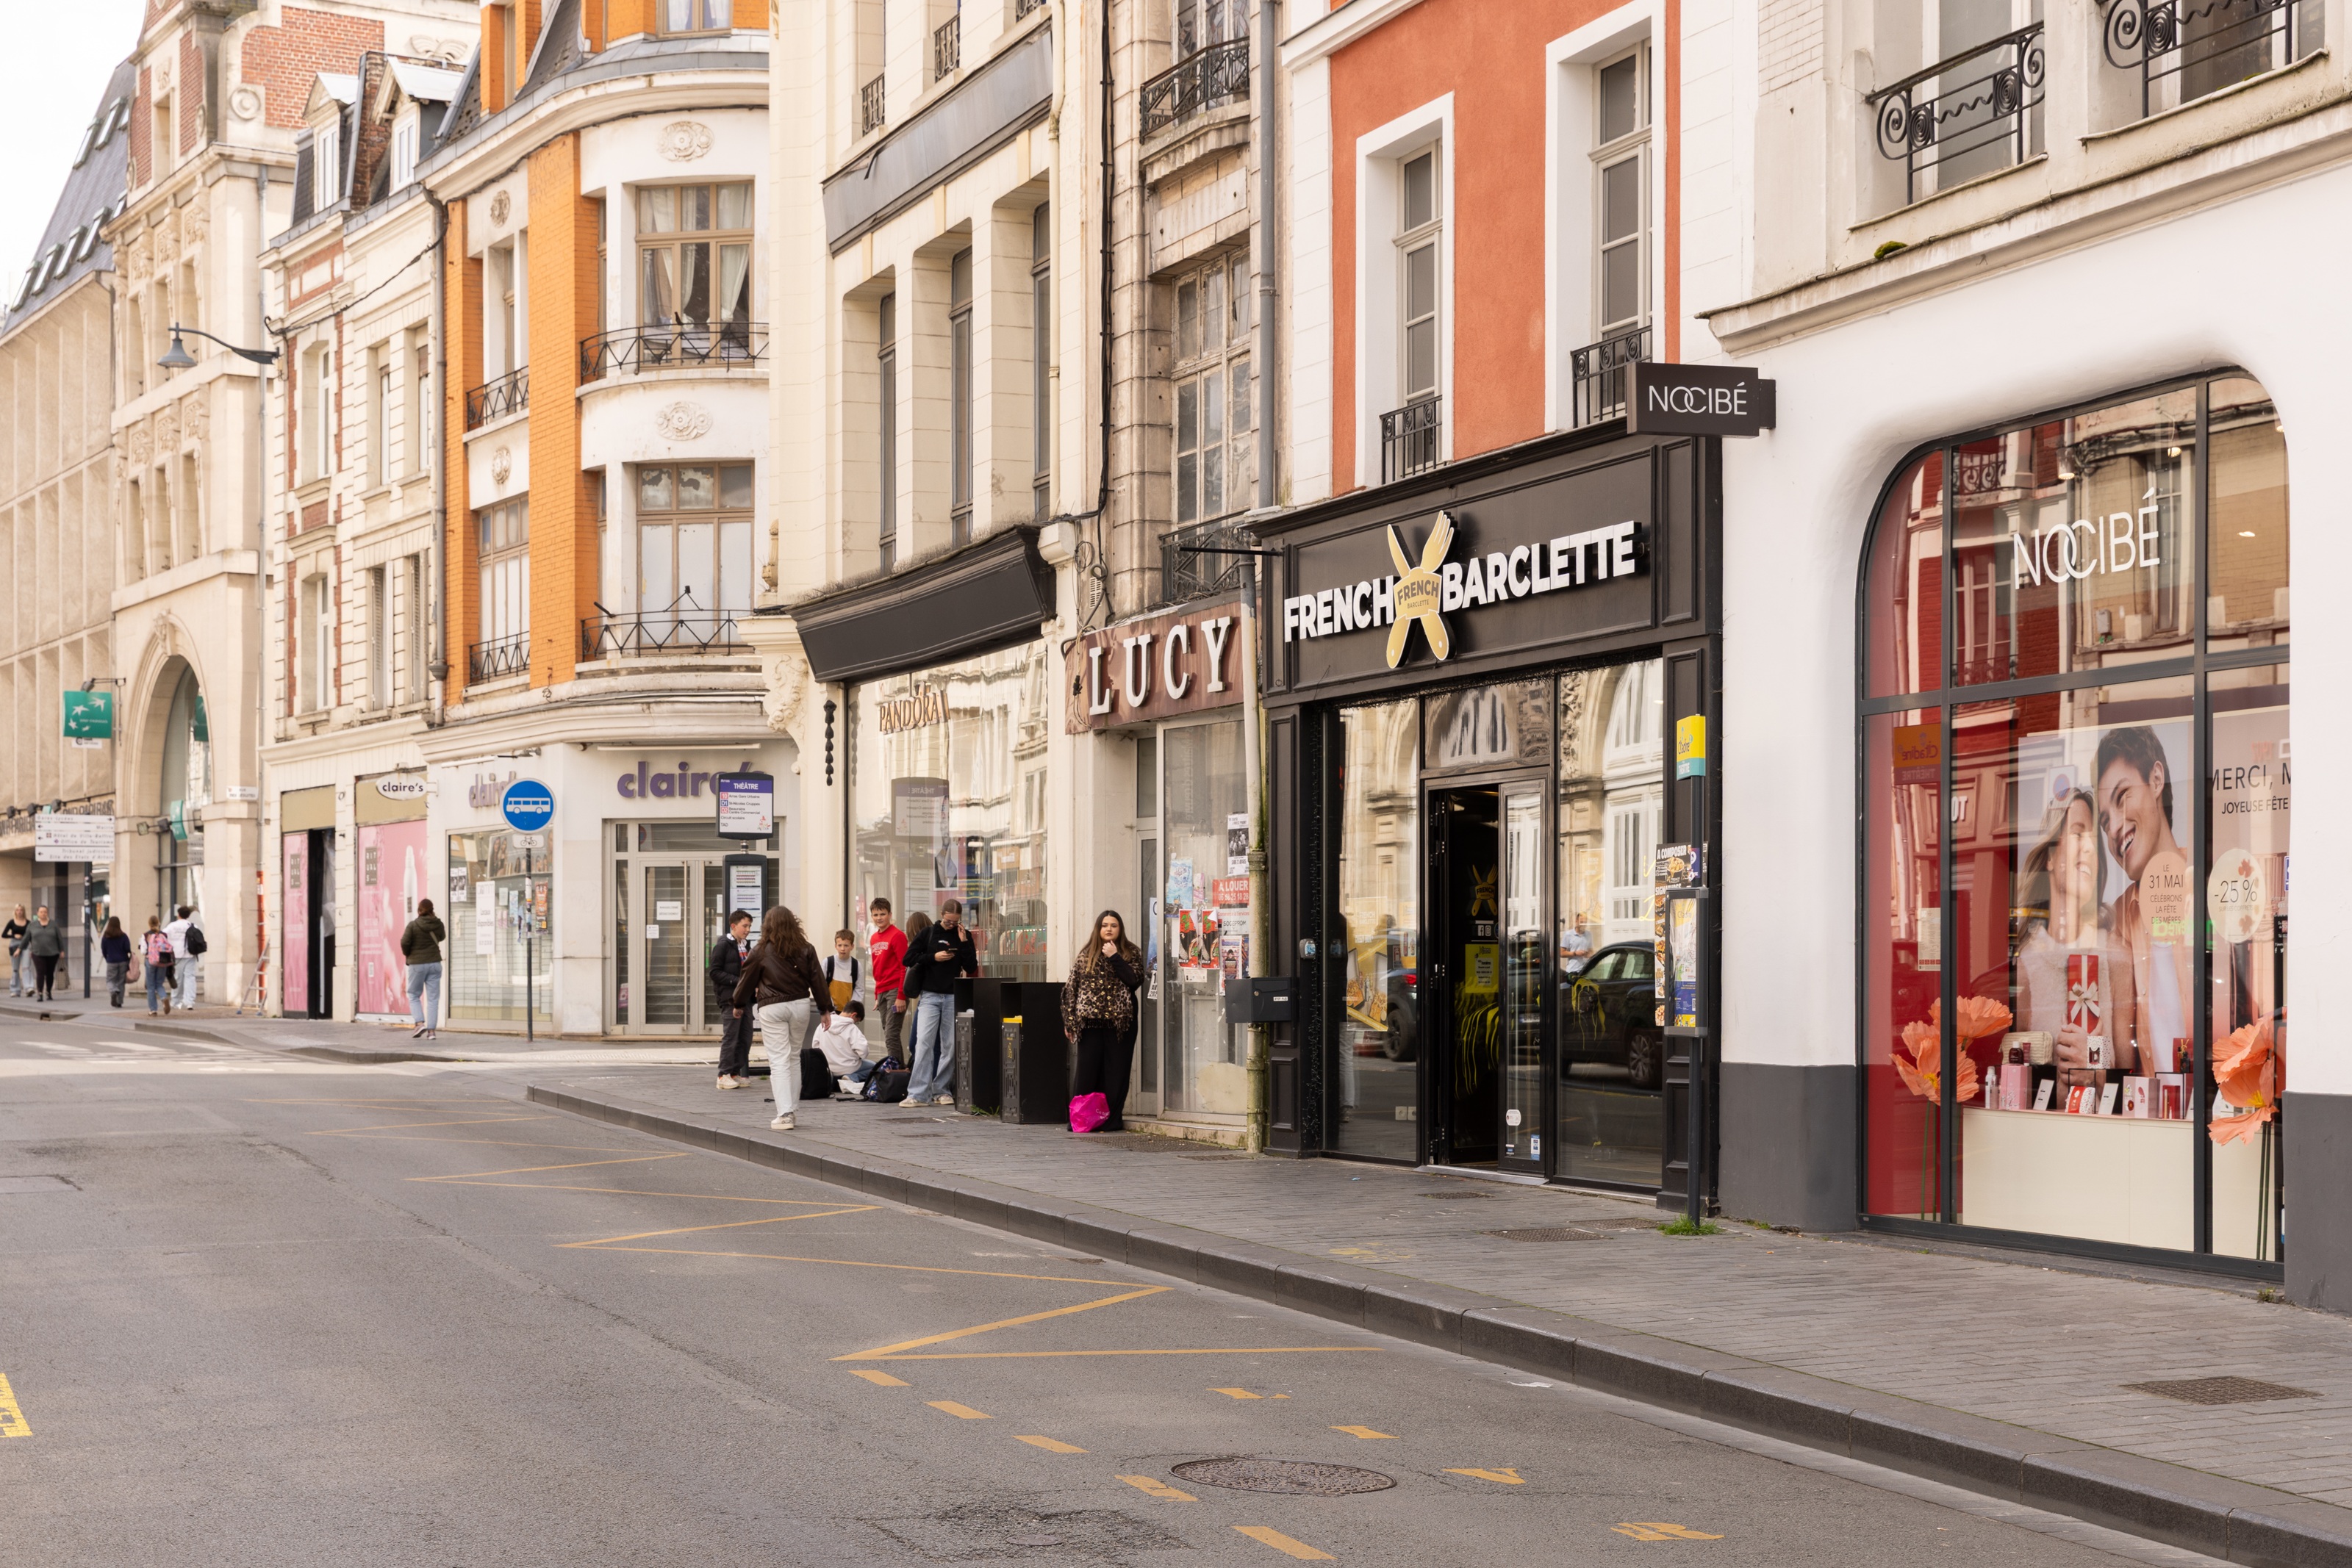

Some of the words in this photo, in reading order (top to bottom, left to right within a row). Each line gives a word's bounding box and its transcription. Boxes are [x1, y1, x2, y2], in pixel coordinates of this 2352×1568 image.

[1649, 381, 1747, 415] NOCIBÉ
[2013, 487, 2160, 589] NOCIBÉ
[1284, 575, 1394, 643] FRENCH
[1442, 520, 1635, 612] BARCLETTE
[1397, 580, 1438, 605] FRENCH
[1408, 599, 1429, 608] BARCLETTE
[1089, 616, 1233, 715] LUCY
[879, 691, 946, 734] PANDORA
[382, 781, 423, 792] claire's
[617, 760, 765, 799] clair'
[734, 782, 759, 790] THÉÂTRE
[2221, 800, 2263, 815] JOYEUSE
[2266, 796, 2289, 810] FÊTE
[1657, 849, 1661, 860] A
[1661, 845, 1687, 859] COMPOSER
[2163, 864, 2169, 872] LE
[1225, 880, 1248, 891] LOUER
[2149, 875, 2159, 888] 31
[2165, 874, 2184, 888] MAI
[1477, 886, 1494, 894] FRENCH
[2150, 893, 2182, 902] CÉLÉBRONS
[2164, 904, 2176, 913] FÊTE
[2151, 916, 2162, 924] DES
